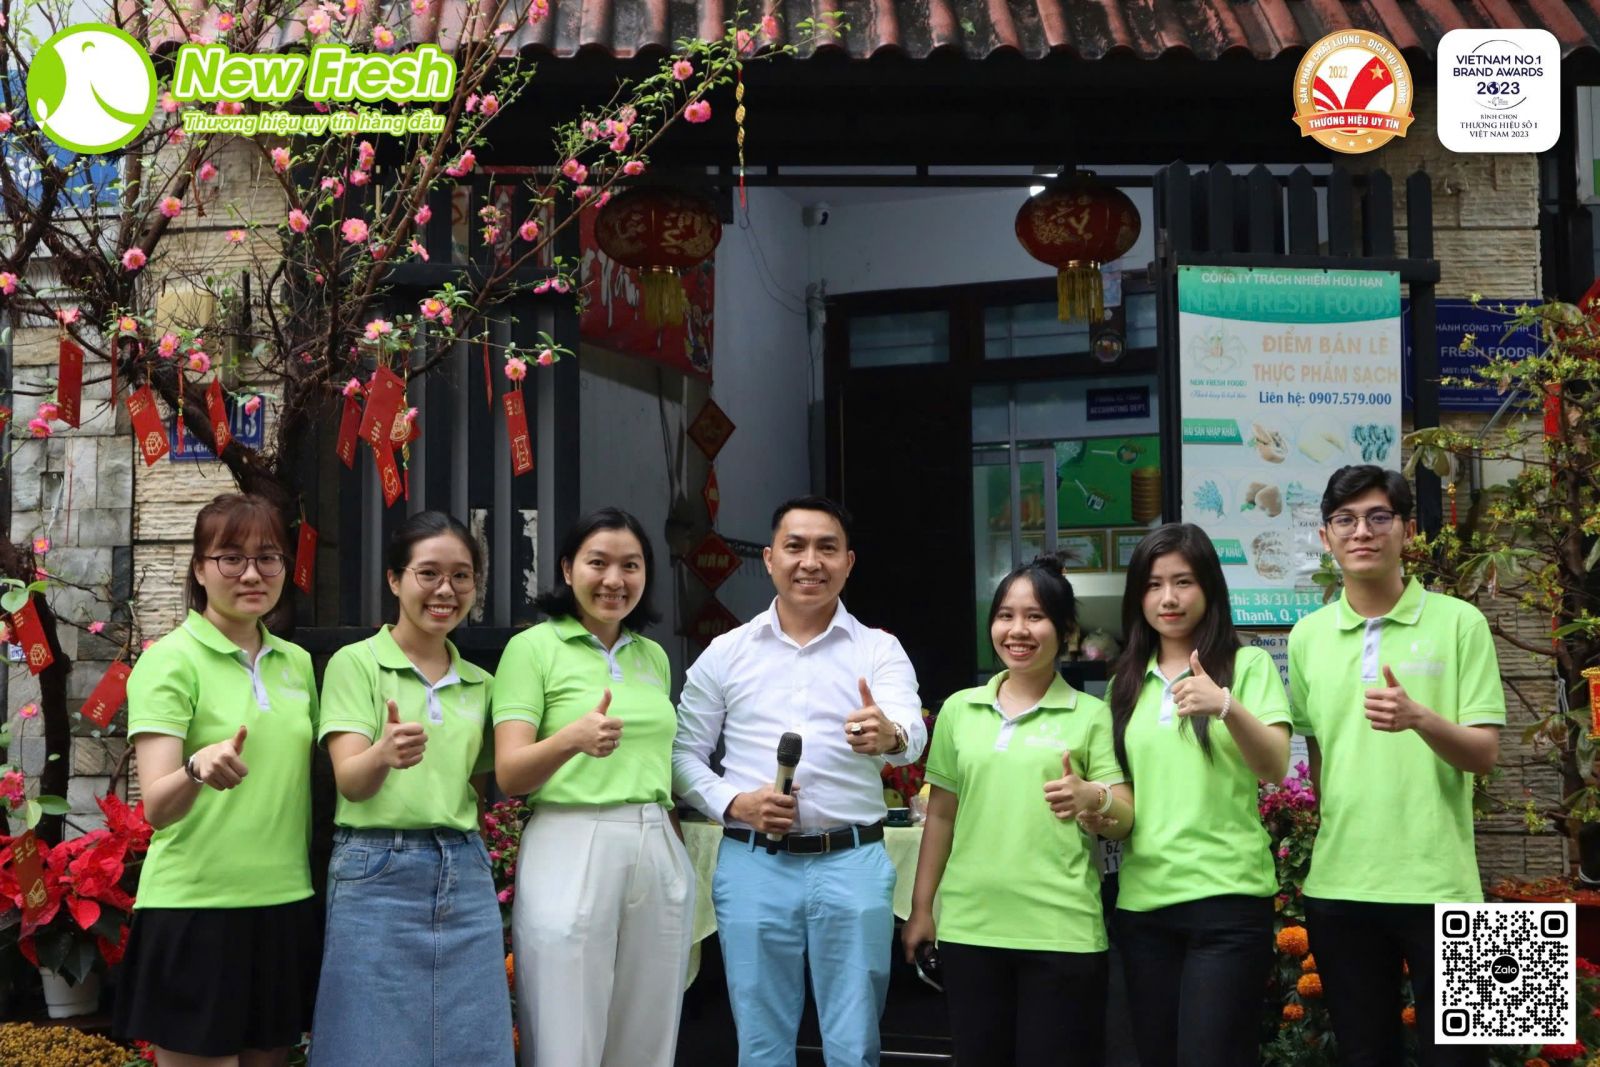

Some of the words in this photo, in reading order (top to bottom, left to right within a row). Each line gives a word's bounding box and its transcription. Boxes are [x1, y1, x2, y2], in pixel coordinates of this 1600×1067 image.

[1201, 270, 1235, 284] CÔNG
[1237, 273, 1251, 284] TY
[1253, 272, 1292, 286] TRÁCH
[1294, 272, 1331, 287] NHIỆM
[1186, 288, 1241, 311] NEW
[1246, 289, 1317, 314] FRESH
[1324, 291, 1395, 315] FOODS
[1435, 323, 1461, 333] HÁNH
[1462, 323, 1489, 333] CÔNG
[1491, 324, 1502, 333] TY
[1262, 326, 1312, 354] ĐIỂM
[1319, 332, 1362, 355] BÁN
[1440, 346, 1484, 358] FRESH
[1488, 346, 1535, 359] FOODS
[1253, 363, 1295, 387] THỰC
[1300, 356, 1348, 384] PHẨM
[1352, 367, 1399, 388] SẠCH
[1259, 391, 1284, 404] Liên
[1287, 391, 1305, 407] hệ:
[1309, 392, 1392, 405] 0907.579.000
[1254, 592, 1311, 606] 38/31/13
[1235, 608, 1277, 624] Thạnh,
[1280, 608, 1293, 622] Q.
[1251, 636, 1276, 647] CÔNG
